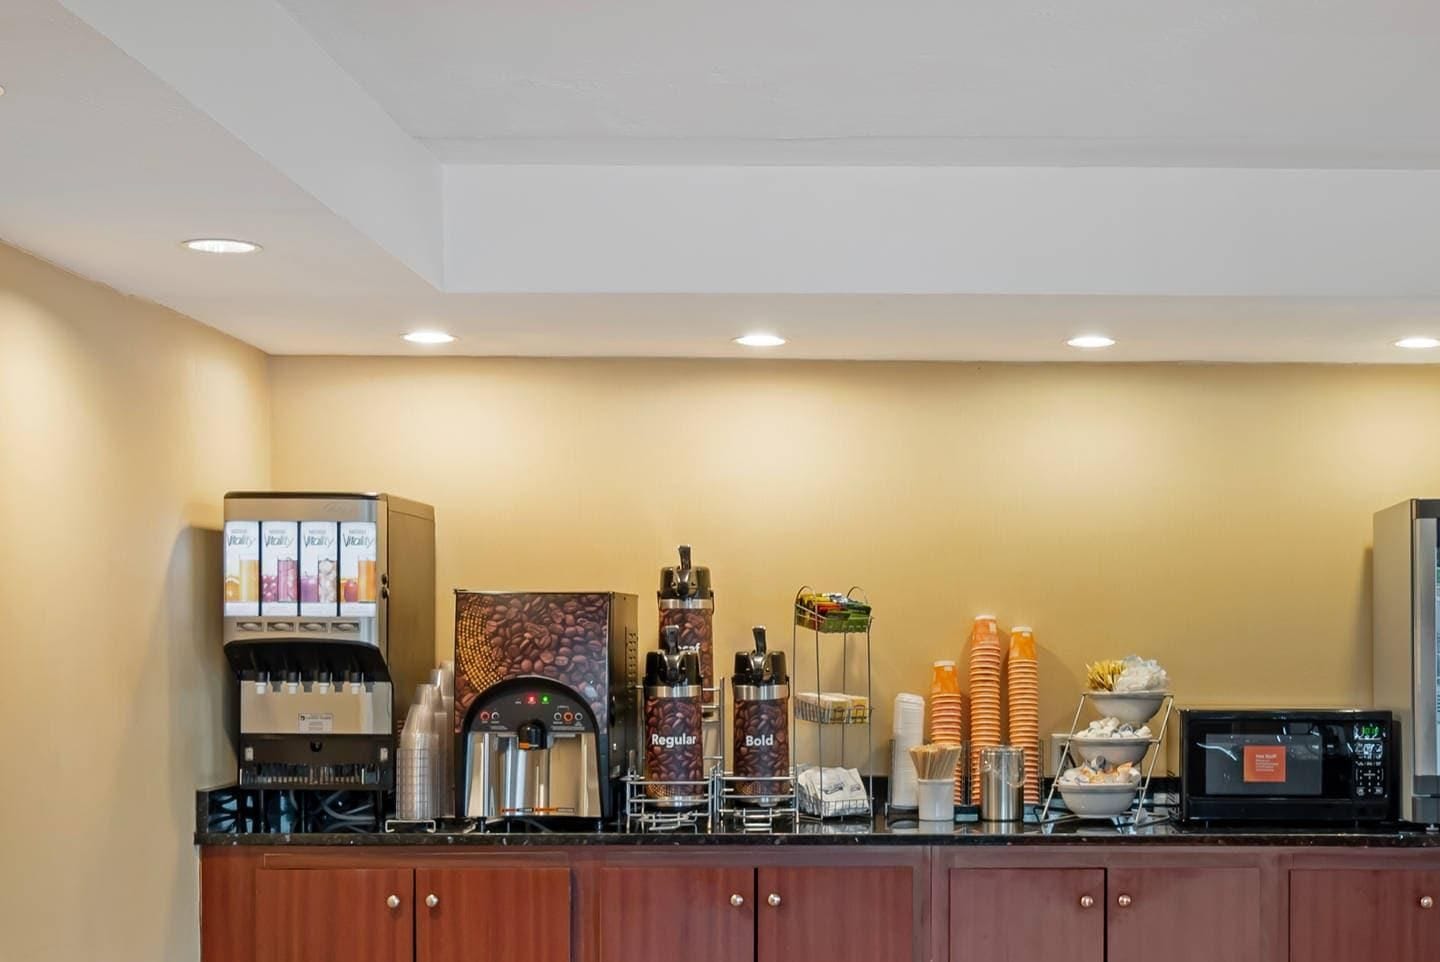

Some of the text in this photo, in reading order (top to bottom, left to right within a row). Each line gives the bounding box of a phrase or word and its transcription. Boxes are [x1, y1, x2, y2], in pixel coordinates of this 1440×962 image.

[227, 534, 256, 548] Vitality
[265, 534, 294, 548] Vitality
[303, 533, 334, 548] Vitality
[342, 532, 374, 548] Vitality
[651, 733, 697, 748] Regular
[745, 734, 774, 747] Bold
